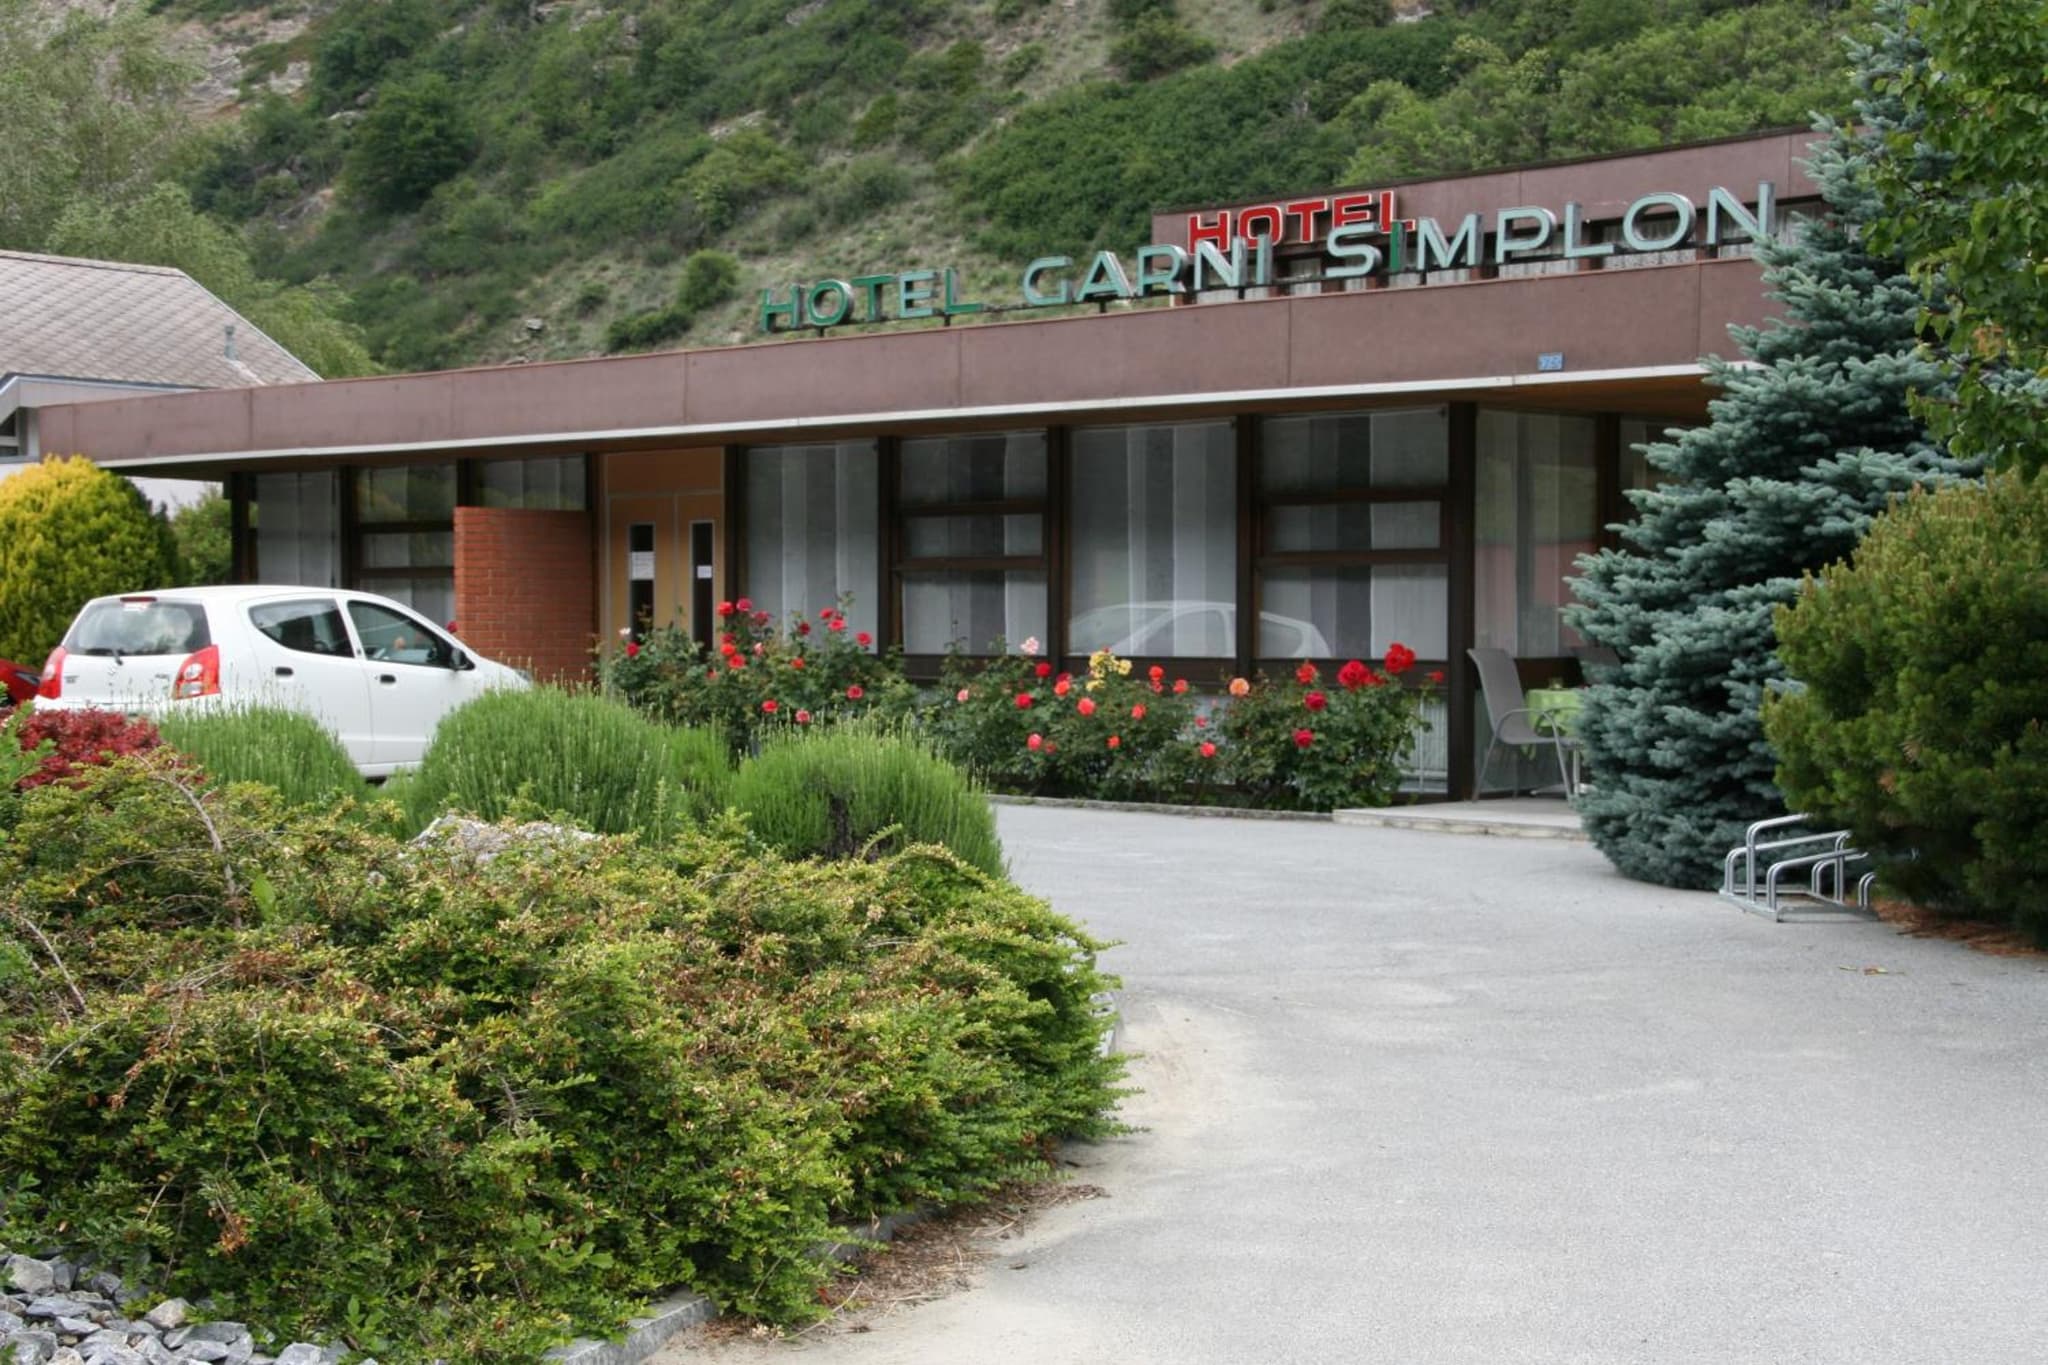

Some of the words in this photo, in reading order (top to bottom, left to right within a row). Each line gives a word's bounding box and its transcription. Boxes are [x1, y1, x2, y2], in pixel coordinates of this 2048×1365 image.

[761, 268, 983, 331] HOTEL
[1024, 234, 1272, 303] GARNI
[1326, 182, 1775, 278] SIMPLON
